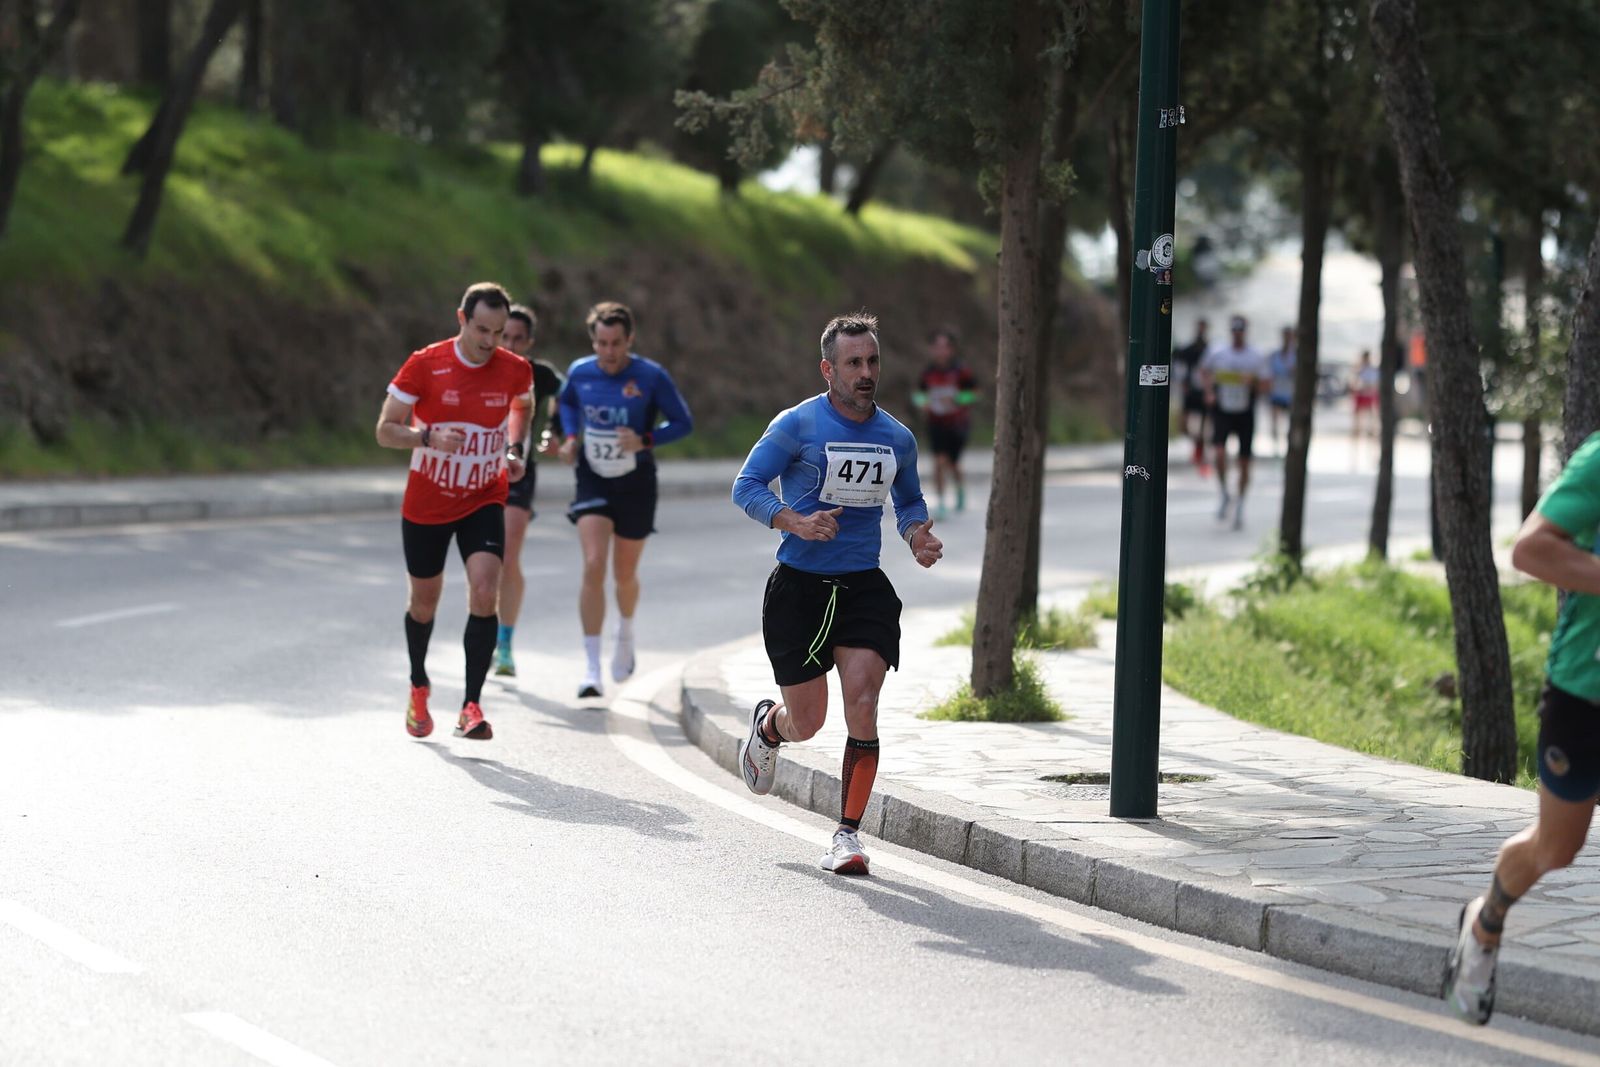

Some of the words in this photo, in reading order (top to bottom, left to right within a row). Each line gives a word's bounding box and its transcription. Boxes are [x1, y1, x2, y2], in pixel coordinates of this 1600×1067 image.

[584, 405, 628, 425] RCM
[593, 443, 625, 461] 322
[838, 459, 884, 485] 471
